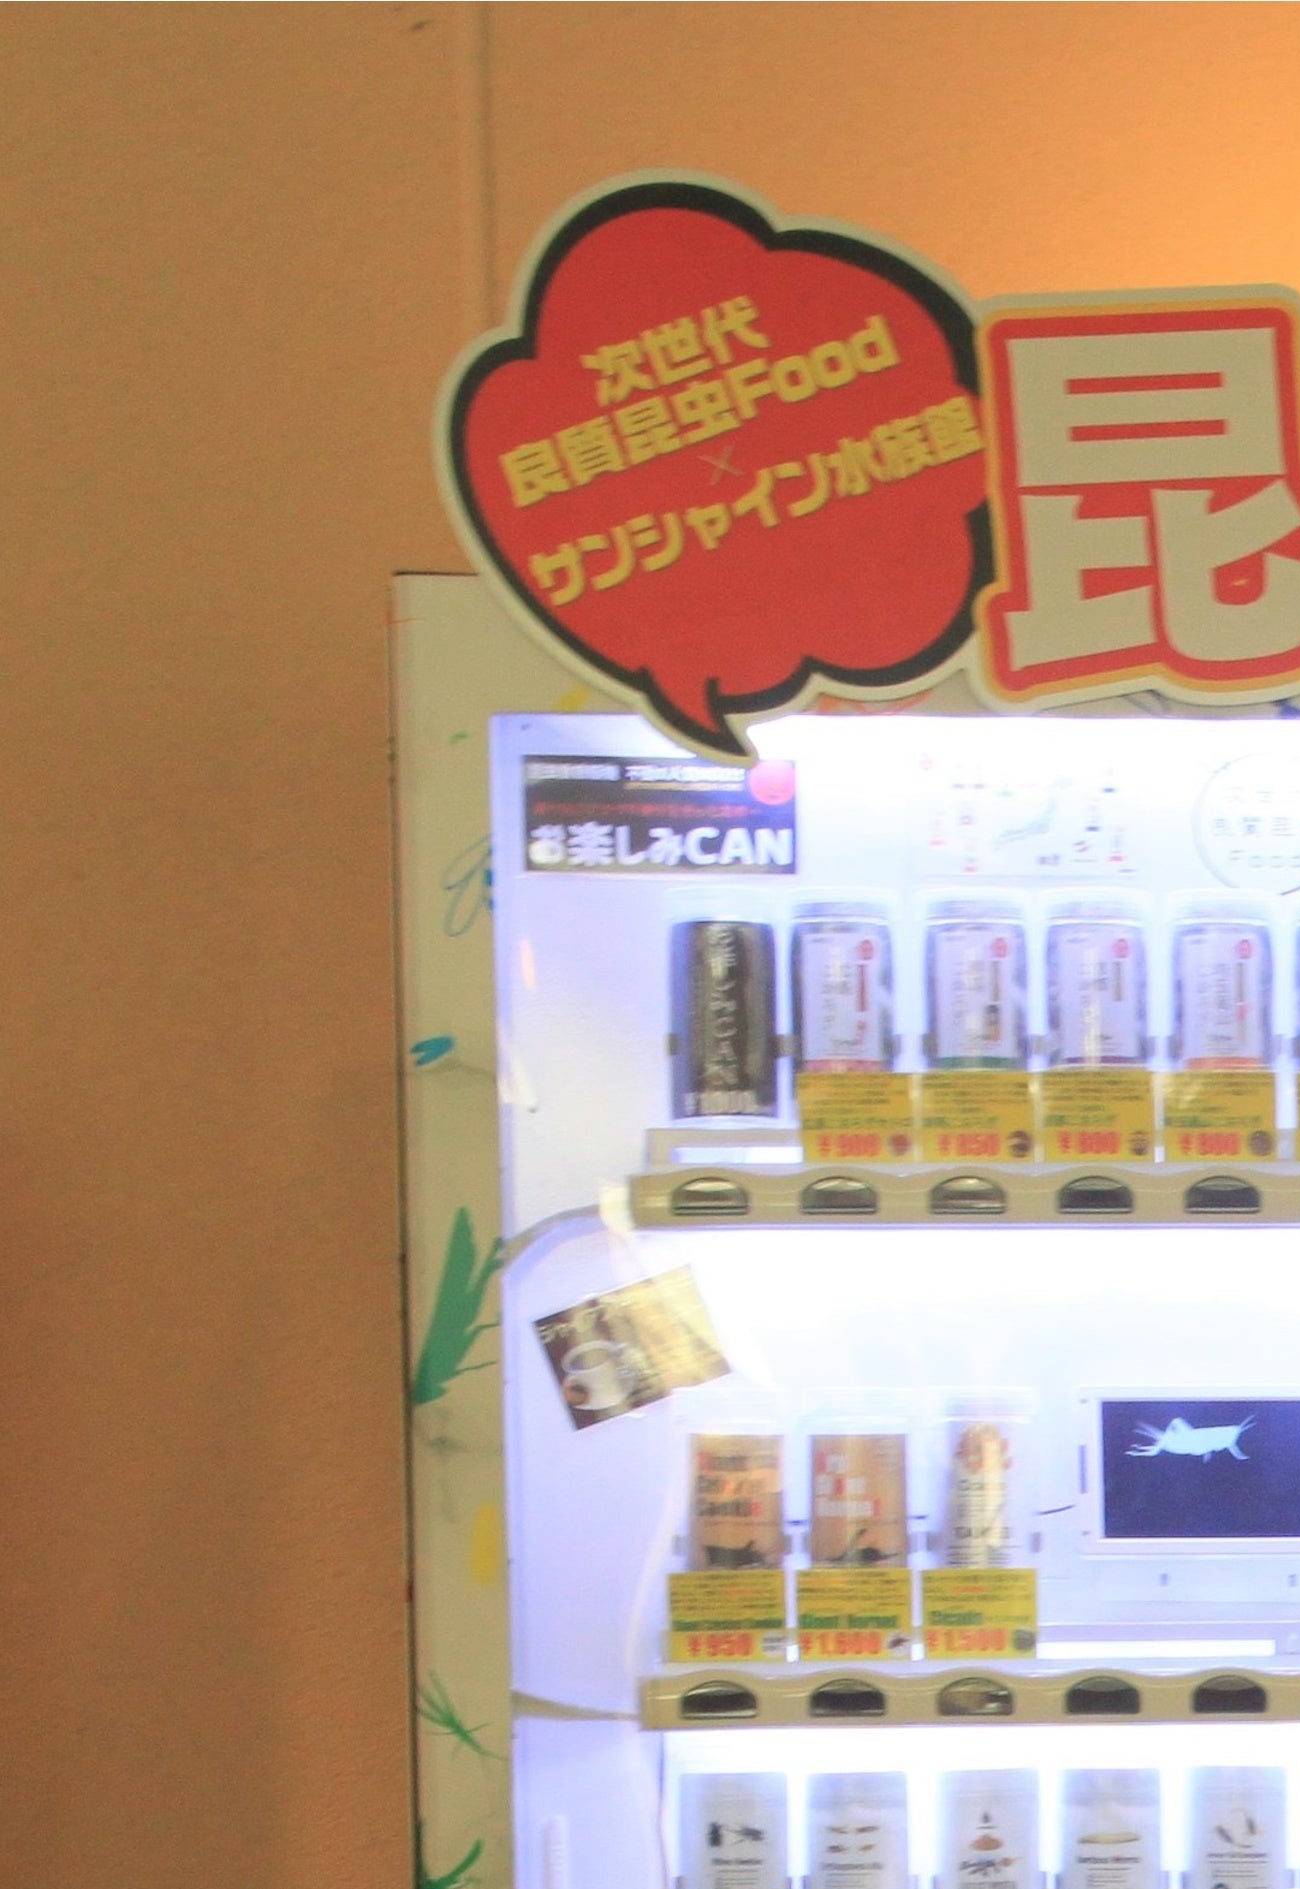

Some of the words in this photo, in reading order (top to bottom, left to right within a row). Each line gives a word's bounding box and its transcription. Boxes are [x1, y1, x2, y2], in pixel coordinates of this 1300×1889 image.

[499, 315, 900, 508] 良質昆虫Food
[580, 296, 770, 407] 次世代
[529, 396, 987, 606] サンシャイン水族館
[528, 821, 794, 866] お楽しみCAN
